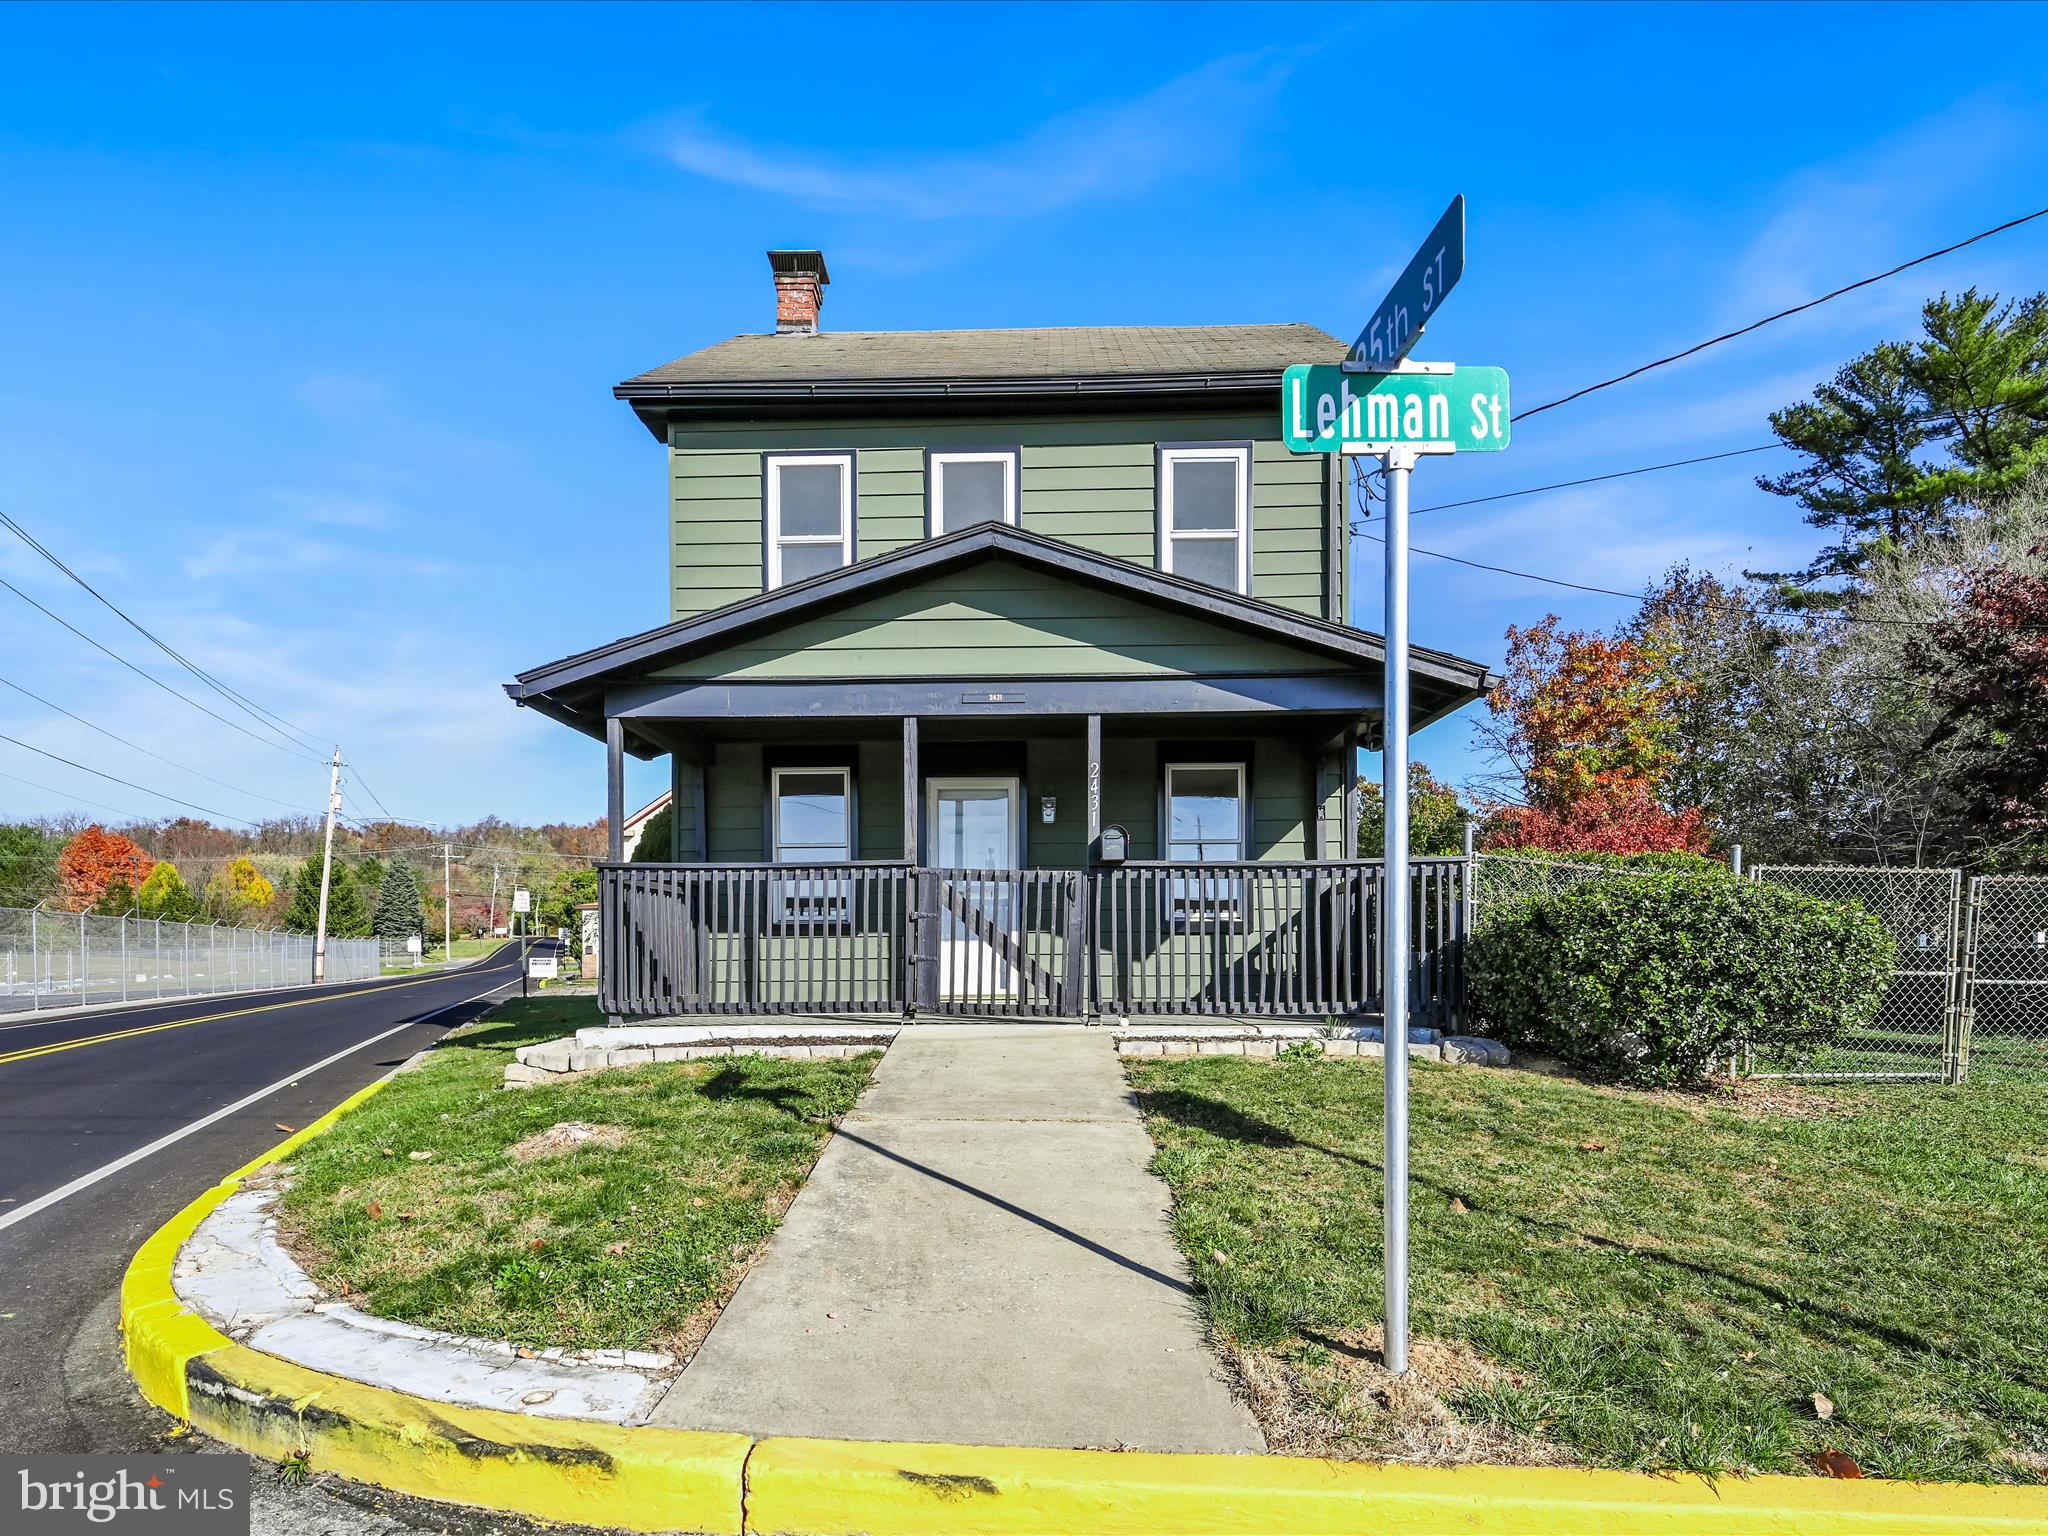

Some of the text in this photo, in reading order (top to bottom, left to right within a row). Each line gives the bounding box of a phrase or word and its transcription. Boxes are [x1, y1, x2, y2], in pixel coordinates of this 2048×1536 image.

[1423, 246, 1446, 313] ST
[1291, 378, 1502, 439] Lehman St
[1090, 763, 1099, 826] 2431
